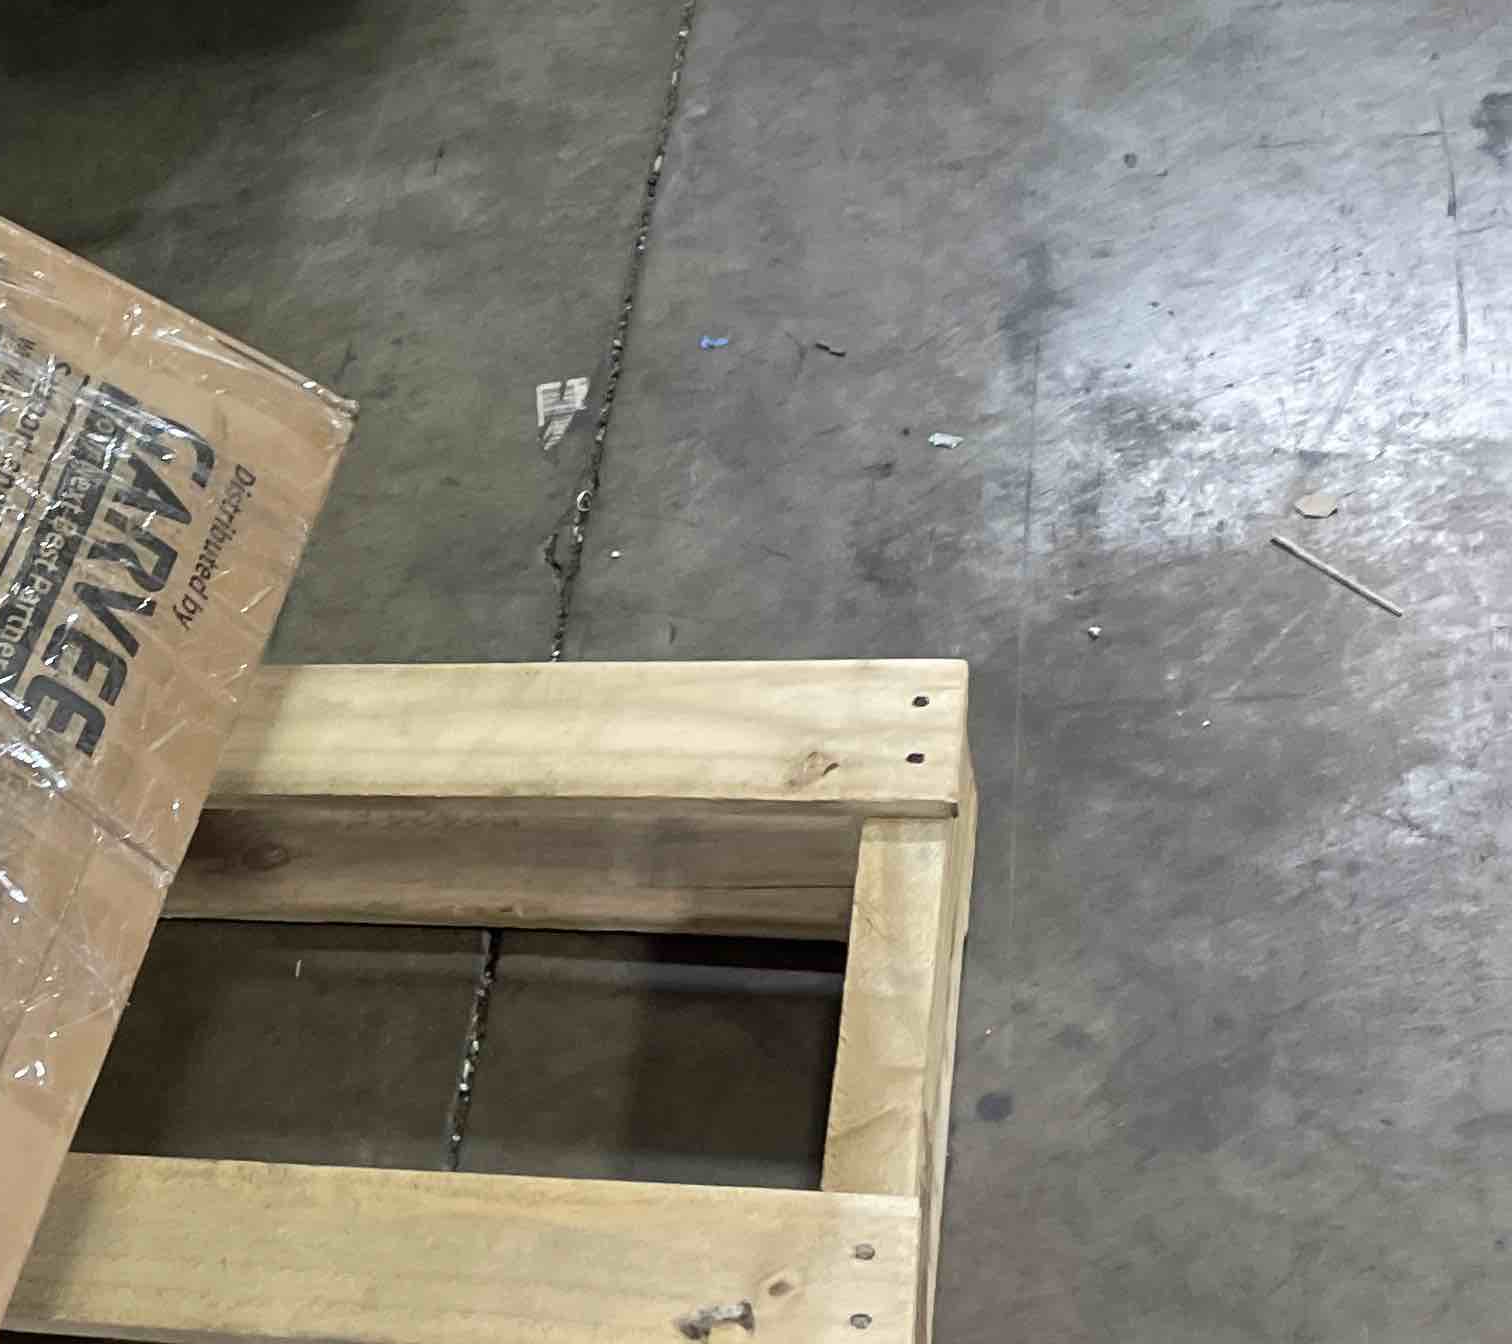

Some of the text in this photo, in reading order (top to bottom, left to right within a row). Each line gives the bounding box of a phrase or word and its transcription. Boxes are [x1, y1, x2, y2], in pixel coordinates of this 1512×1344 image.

[33, 516, 75, 574] Best
[169, 464, 260, 632] Distributed by
